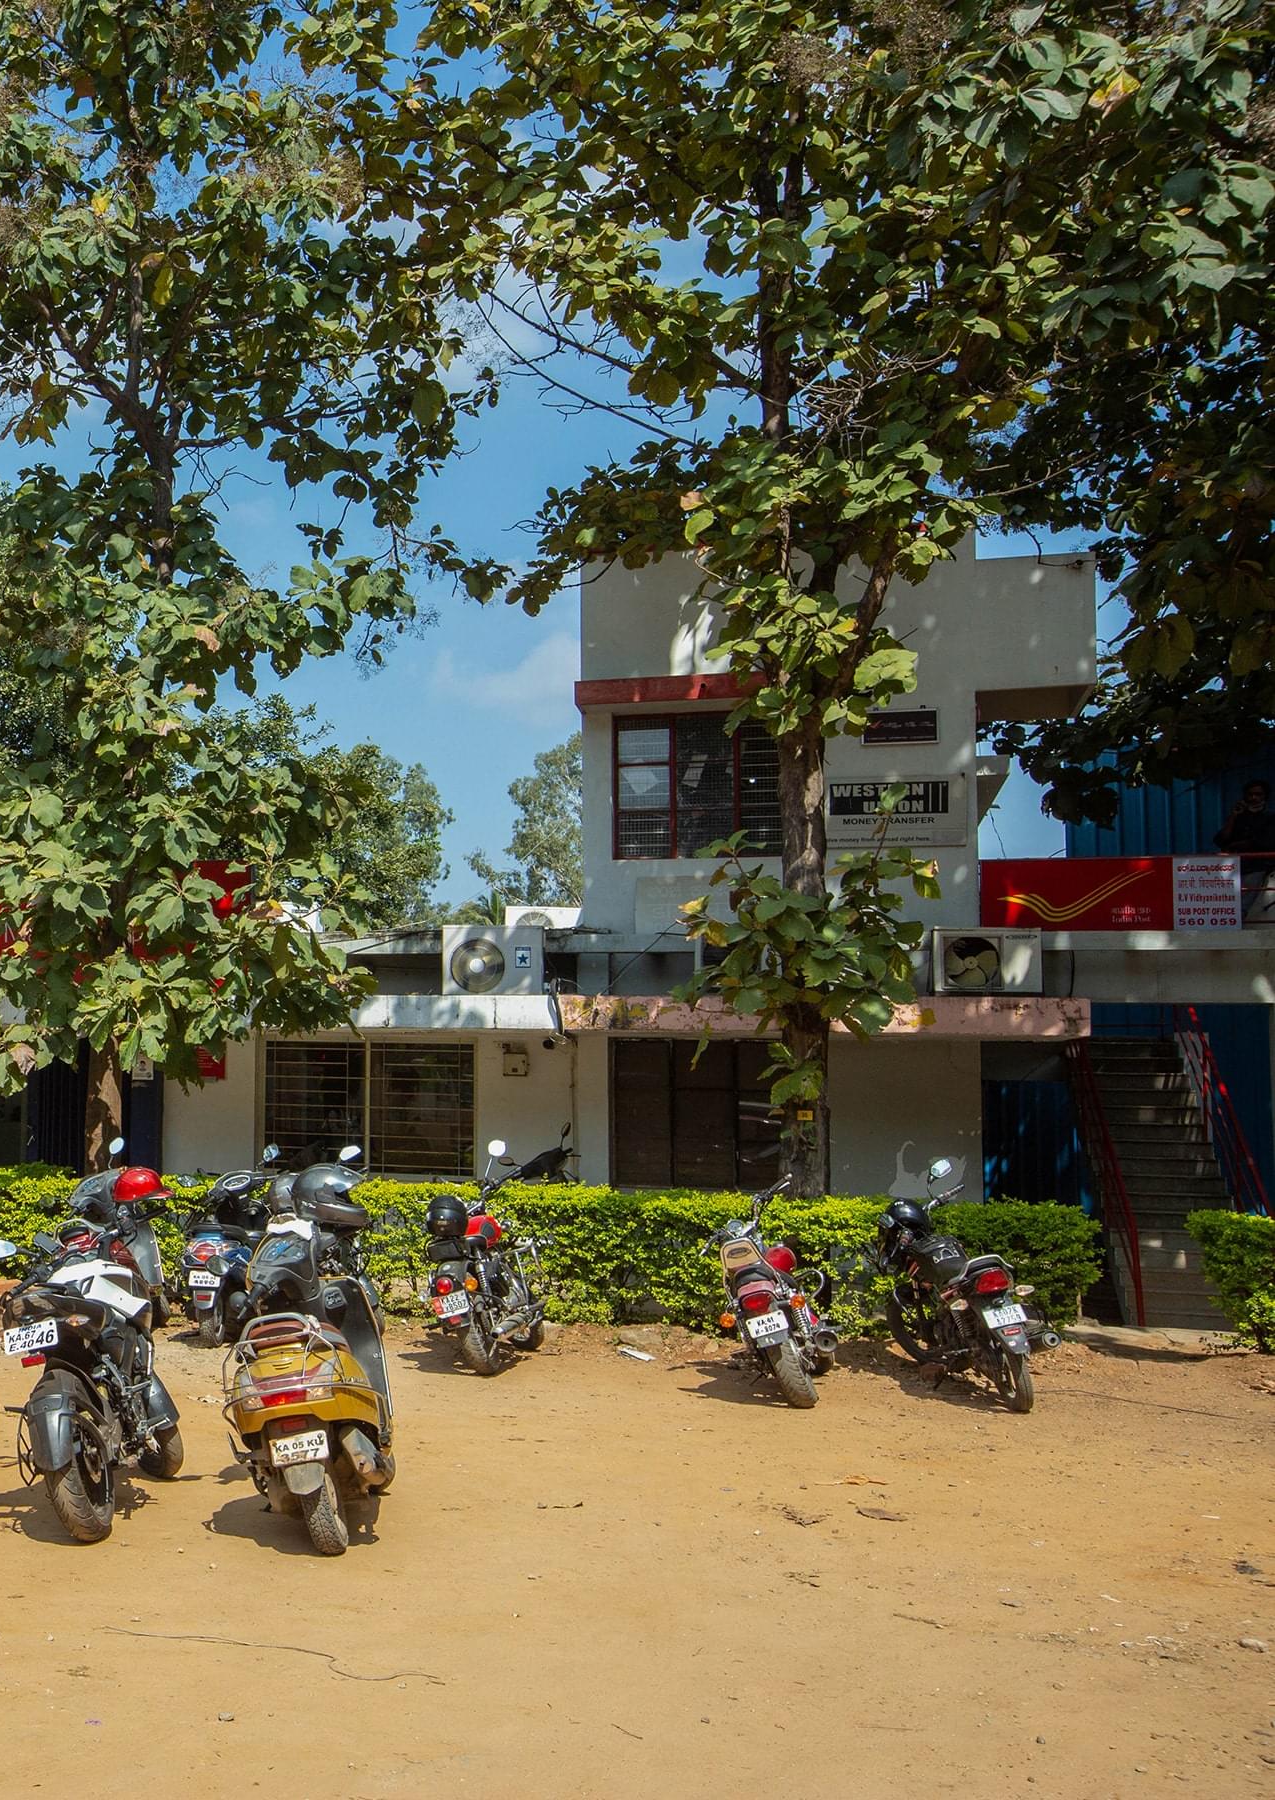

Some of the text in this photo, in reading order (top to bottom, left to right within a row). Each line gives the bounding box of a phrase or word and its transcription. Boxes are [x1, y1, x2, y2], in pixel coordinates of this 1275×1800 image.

[832, 783, 924, 797] WESTN
[863, 800, 924, 813] UON
[1179, 918, 1237, 926] 560 059
[18, 1324, 42, 1332] INDIA
[8, 1330, 36, 1344] KA.67
[275, 1444, 290, 1453] KA
[292, 1441, 304, 1450] 05
